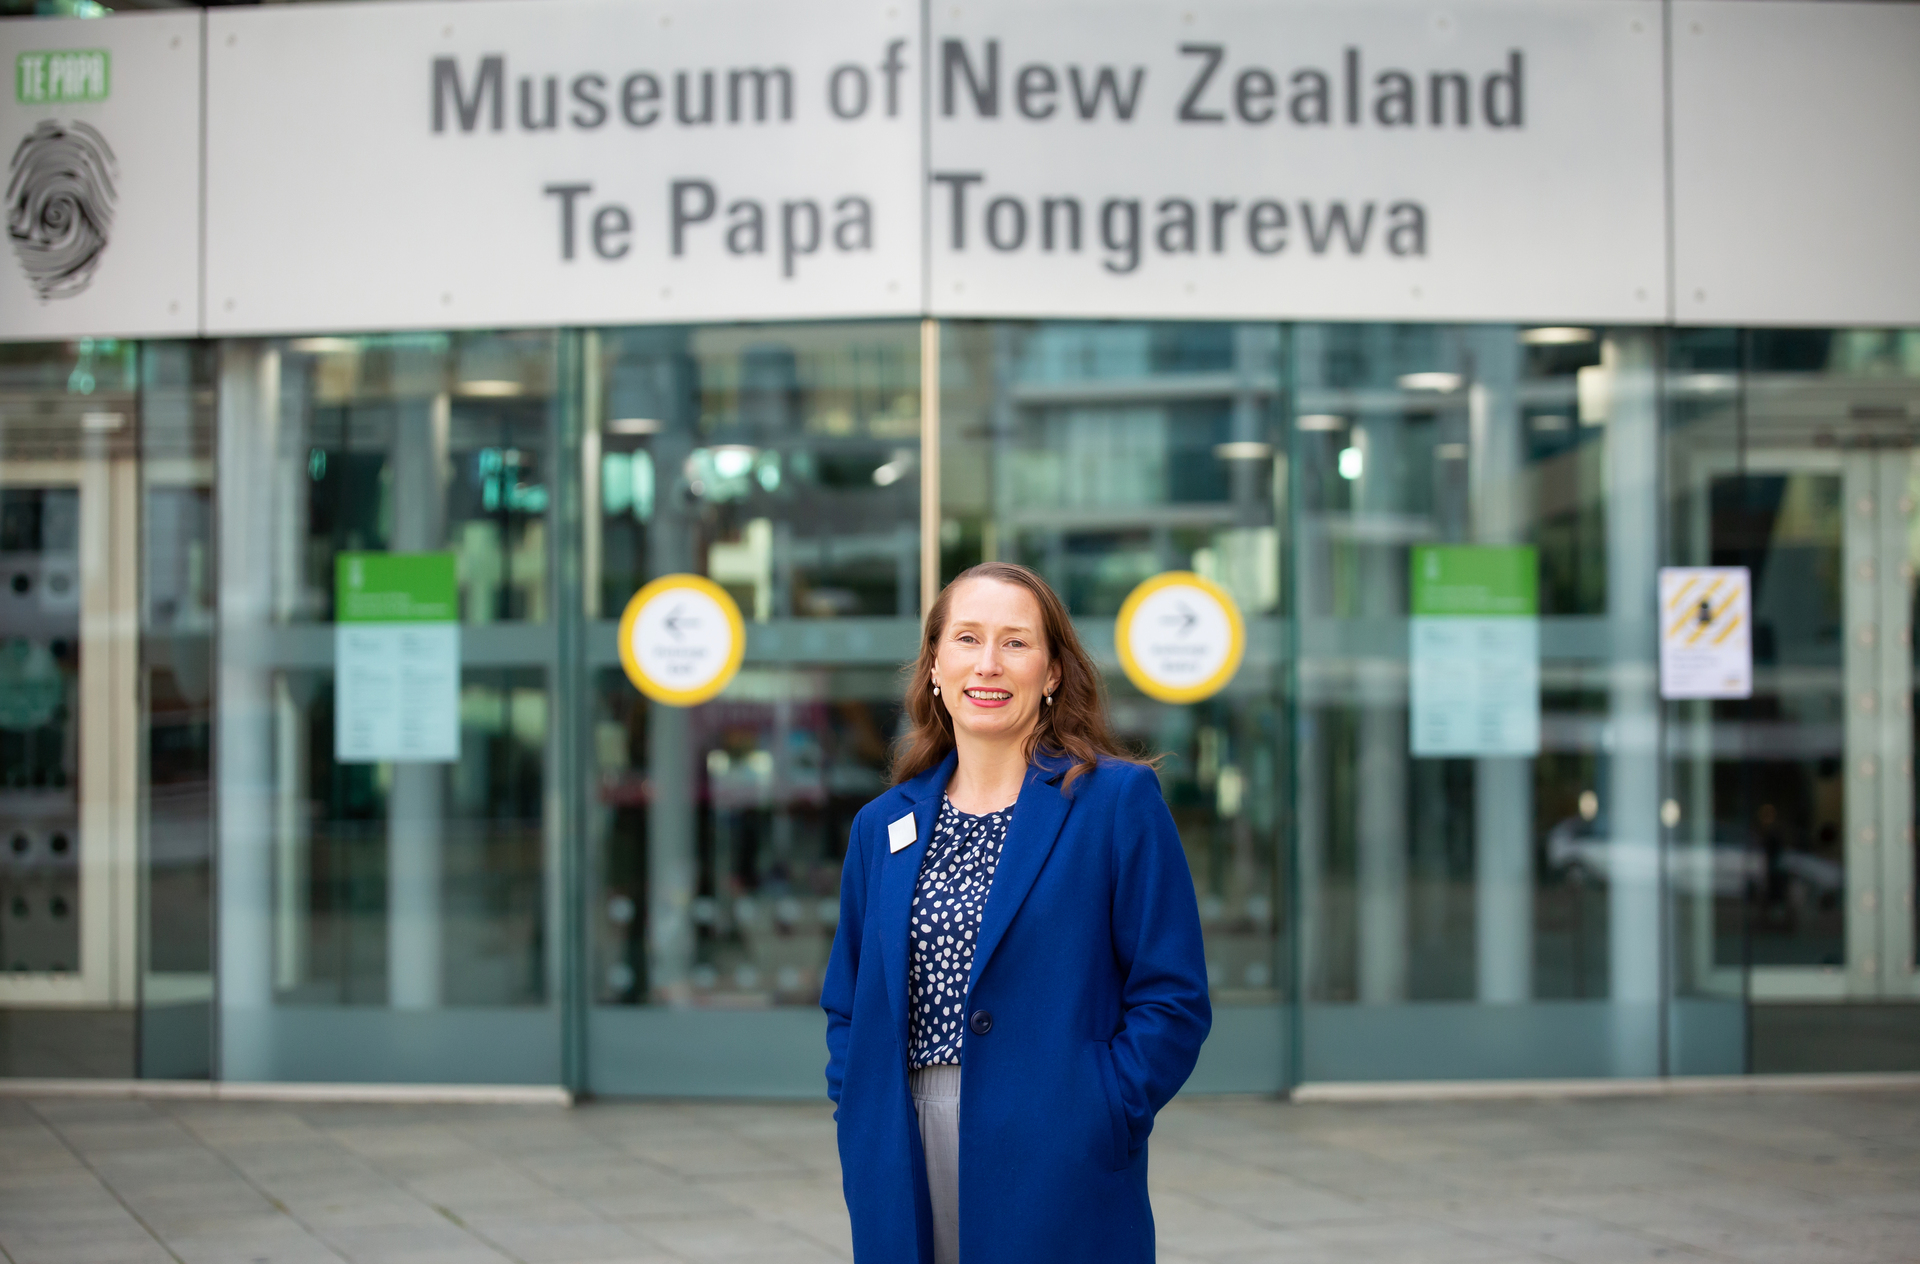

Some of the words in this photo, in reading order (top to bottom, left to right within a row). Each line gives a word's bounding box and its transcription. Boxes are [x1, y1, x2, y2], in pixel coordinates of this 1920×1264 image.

[21, 54, 47, 100] TE
[49, 52, 105, 99] PAPA
[431, 54, 794, 133] Museum
[828, 40, 906, 120] of
[941, 37, 1147, 122] New
[1175, 41, 1528, 130] Zealand
[543, 183, 632, 259] Te
[670, 178, 872, 277] Papa
[931, 172, 1429, 273] Tongarewa
